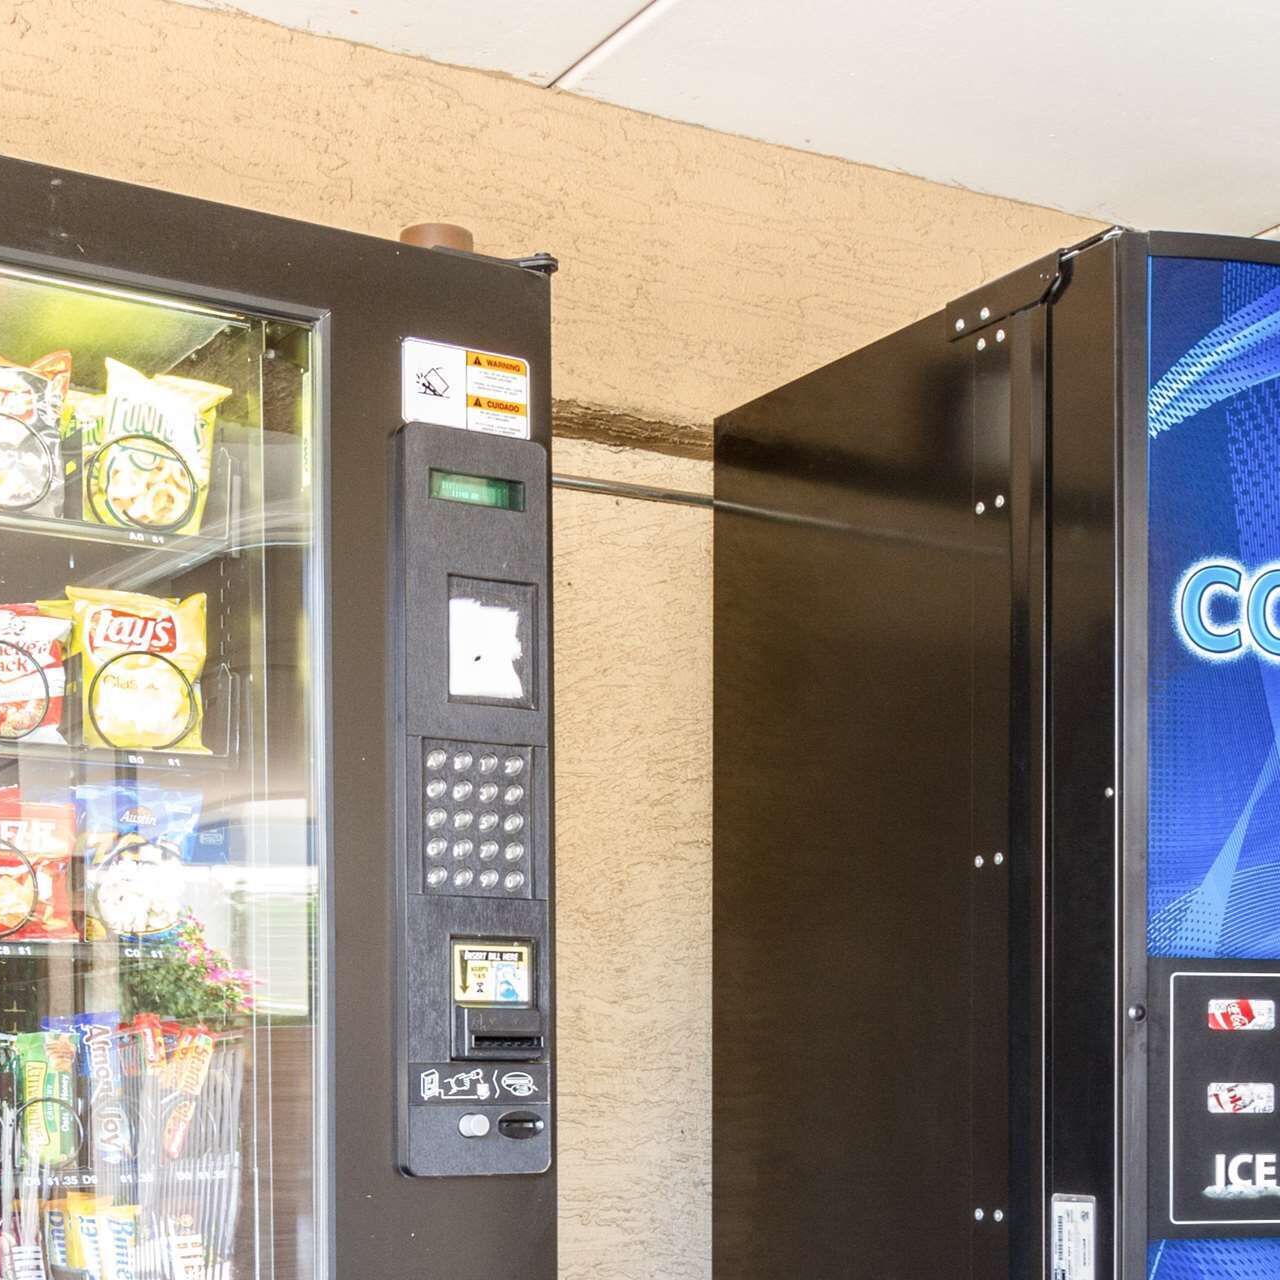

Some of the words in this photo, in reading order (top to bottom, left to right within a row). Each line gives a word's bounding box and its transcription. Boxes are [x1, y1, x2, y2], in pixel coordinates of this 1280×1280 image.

[486, 358, 521, 373] WARNING
[486, 400, 520, 414] CUIDADO
[119, 809, 158, 826] Austin
[464, 949, 487, 961] INSERT
[488, 951, 501, 961] BILL
[502, 952, 519, 962] HERE
[1214, 1153, 1278, 1192] ICE
